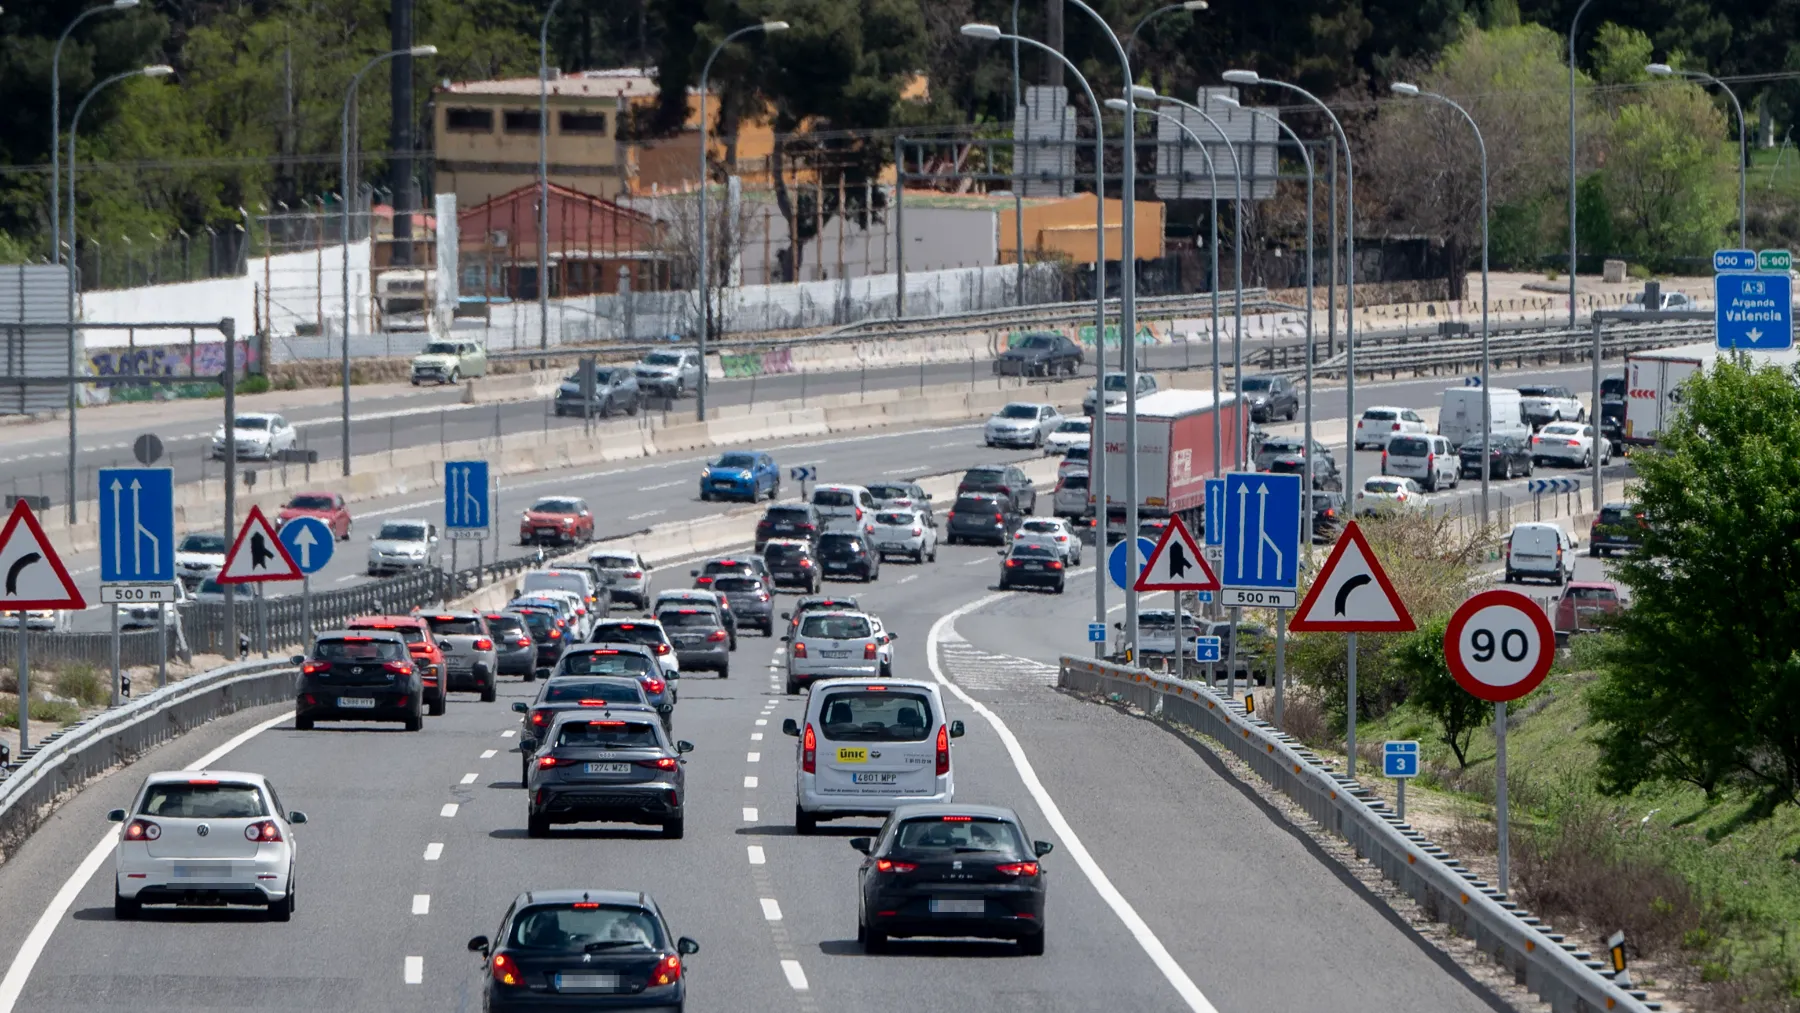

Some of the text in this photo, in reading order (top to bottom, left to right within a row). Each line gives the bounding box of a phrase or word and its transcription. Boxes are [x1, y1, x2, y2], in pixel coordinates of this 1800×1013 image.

[1717, 256, 1754, 266] 500 m
[1761, 256, 1789, 266] E-901
[1744, 282, 1763, 293] A-3
[1732, 297, 1775, 309] Arganda
[1725, 309, 1782, 322] Valencia
[115, 589, 161, 600] 500 m
[1237, 592, 1280, 604] 500 m
[1471, 628, 1529, 663] 90
[1204, 648, 1213, 658] 4
[1396, 744, 1405, 752] 14
[1396, 758, 1406, 770] 3
[857, 773, 897, 782] 4801 MPP
